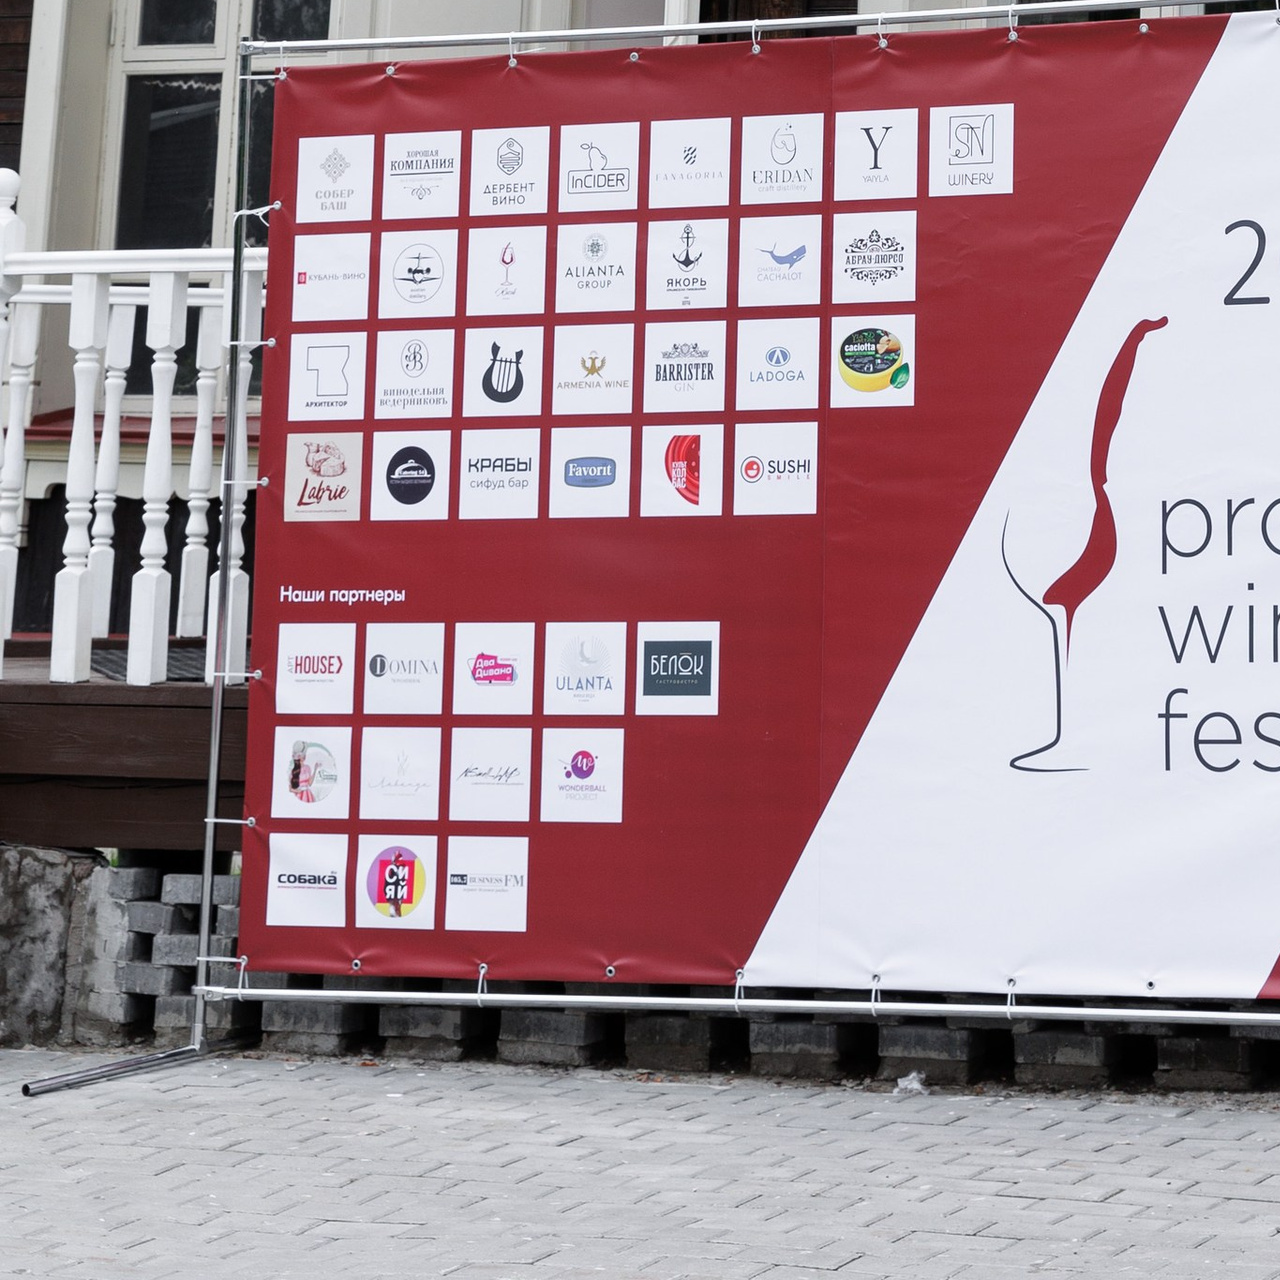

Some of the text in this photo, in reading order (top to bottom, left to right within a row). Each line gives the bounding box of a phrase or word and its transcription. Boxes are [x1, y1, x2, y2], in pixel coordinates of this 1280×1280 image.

[406, 150, 439, 158] ХОРОШАЯ
[860, 126, 893, 170] Y
[390, 158, 454, 171] КОМПАНИЯ
[571, 173, 626, 189] InCIDER
[655, 171, 723, 181] FANAGORIA
[752, 168, 814, 184] ERIDAN
[948, 172, 994, 186] WINERY
[483, 183, 535, 194] ДЕРБЕНТ
[776, 183, 807, 192] distillery
[315, 189, 354, 200] СОБЕР
[492, 195, 526, 206] ВИНО
[320, 202, 347, 211] БАШ
[565, 265, 625, 278] ALIANTA
[757, 272, 802, 282] CACHALOT
[577, 280, 612, 290] GROUP
[666, 277, 707, 288] ЯКОРЬ
[655, 362, 714, 382] BARRISTER
[749, 370, 805, 382] LADOGA
[556, 380, 629, 389] ARMENIA WINE
[674, 382, 695, 392] GIN
[305, 400, 348, 408] АРХИТЕКТОР
[468, 457, 532, 473] КРАБЫ
[768, 459, 811, 474] SUSHI
[470, 477, 529, 490] сифуд бар
[280, 585, 406, 606] Наши партнеры
[294, 655, 335, 674] HOUSE
[475, 658, 495, 669] Два
[651, 653, 704, 676] БЕЛОК
[474, 666, 512, 679] Дивана
[556, 676, 613, 691] ULANTA
[558, 784, 607, 793] WONDERBALL
[385, 865, 409, 883] СИ
[505, 875, 524, 887] FM
[385, 881, 408, 900] ЯЙ
